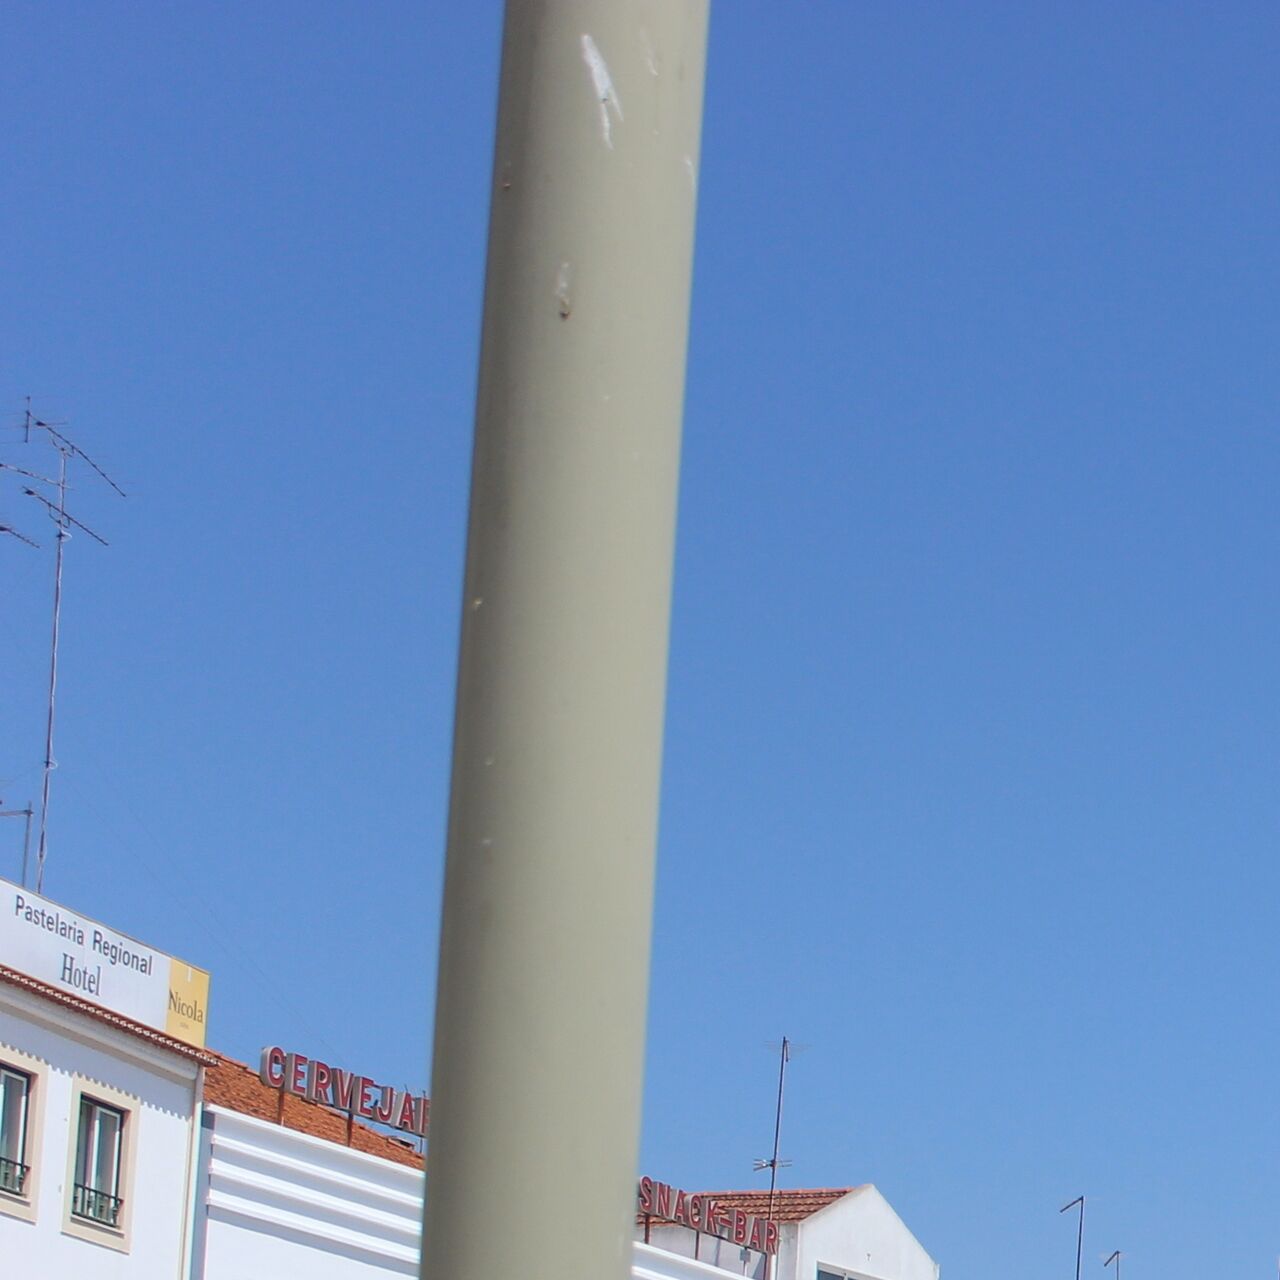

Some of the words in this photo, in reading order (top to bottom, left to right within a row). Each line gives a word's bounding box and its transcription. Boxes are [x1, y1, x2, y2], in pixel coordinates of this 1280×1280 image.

[15, 894, 84, 946] Pastelaria
[92, 930, 153, 977] Regional
[60, 953, 101, 997] Hotel
[168, 988, 204, 1024] Nicola
[639, 1176, 780, 1255] SNACK-BAR
